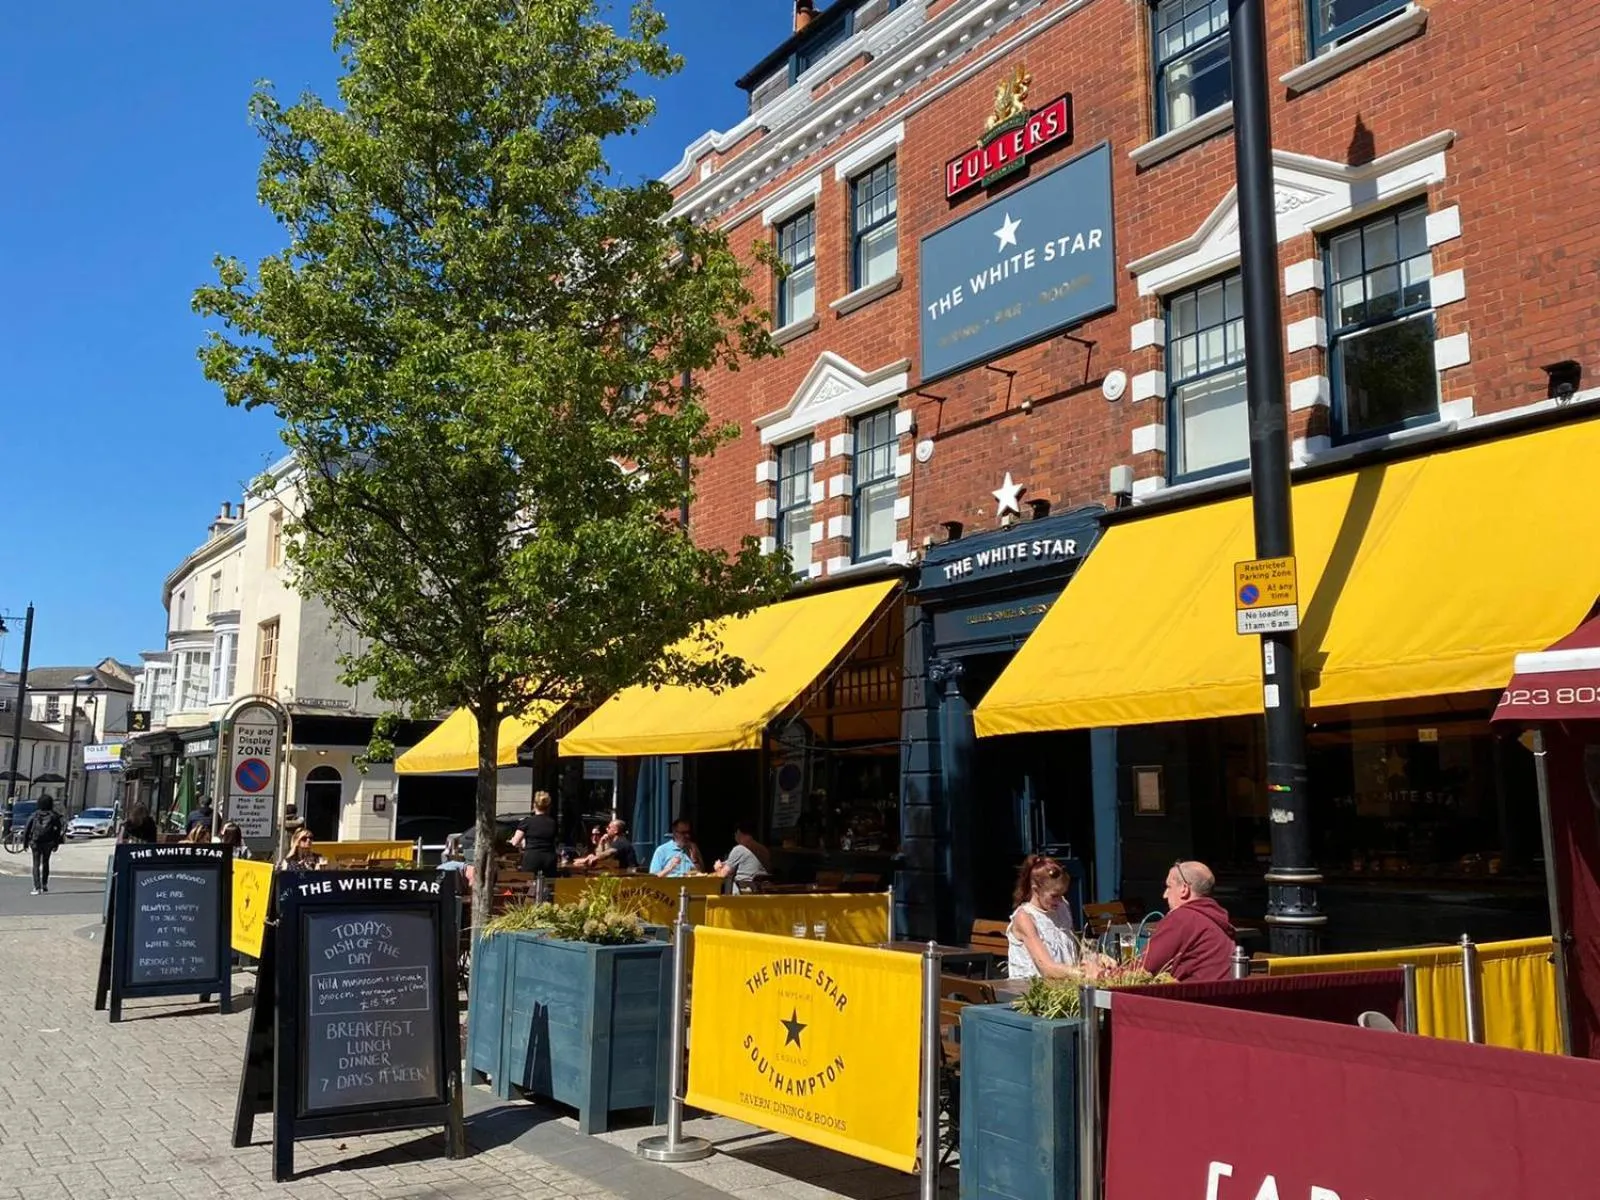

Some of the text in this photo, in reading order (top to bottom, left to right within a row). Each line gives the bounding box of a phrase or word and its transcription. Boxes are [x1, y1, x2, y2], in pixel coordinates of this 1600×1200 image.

[952, 111, 1058, 187] FULLER'S
[928, 228, 1102, 320] THE WHITE STAR
[943, 538, 1077, 579] THE WHITE STAR
[1244, 561, 1286, 572] Restricted
[1239, 569, 1292, 582] Parking Zone
[1267, 583, 1293, 593] At any
[1271, 591, 1289, 600] time
[1245, 608, 1289, 619] No loading
[1556, 687, 1600, 704] 80
[238, 727, 273, 736] Pay and
[239, 736, 272, 745] Display
[237, 746, 272, 756] ZONE
[130, 847, 224, 859] THE WHITE STAR
[298, 881, 332, 897] THE
[338, 878, 393, 891] WHITE
[399, 880, 441, 894] STAR
[324, 938, 401, 960] DISH OF THE
[347, 952, 373, 965] DAY
[746, 958, 848, 1012] THE WHITE STAR
[347, 1040, 392, 1055] LUNCH
[339, 1052, 392, 1069] DINNER
[744, 1034, 845, 1097] SOUTHAMPTON
[320, 1078, 329, 1092] 7
[337, 1072, 374, 1090] DAYS
[814, 1112, 847, 1131] ROOMS
